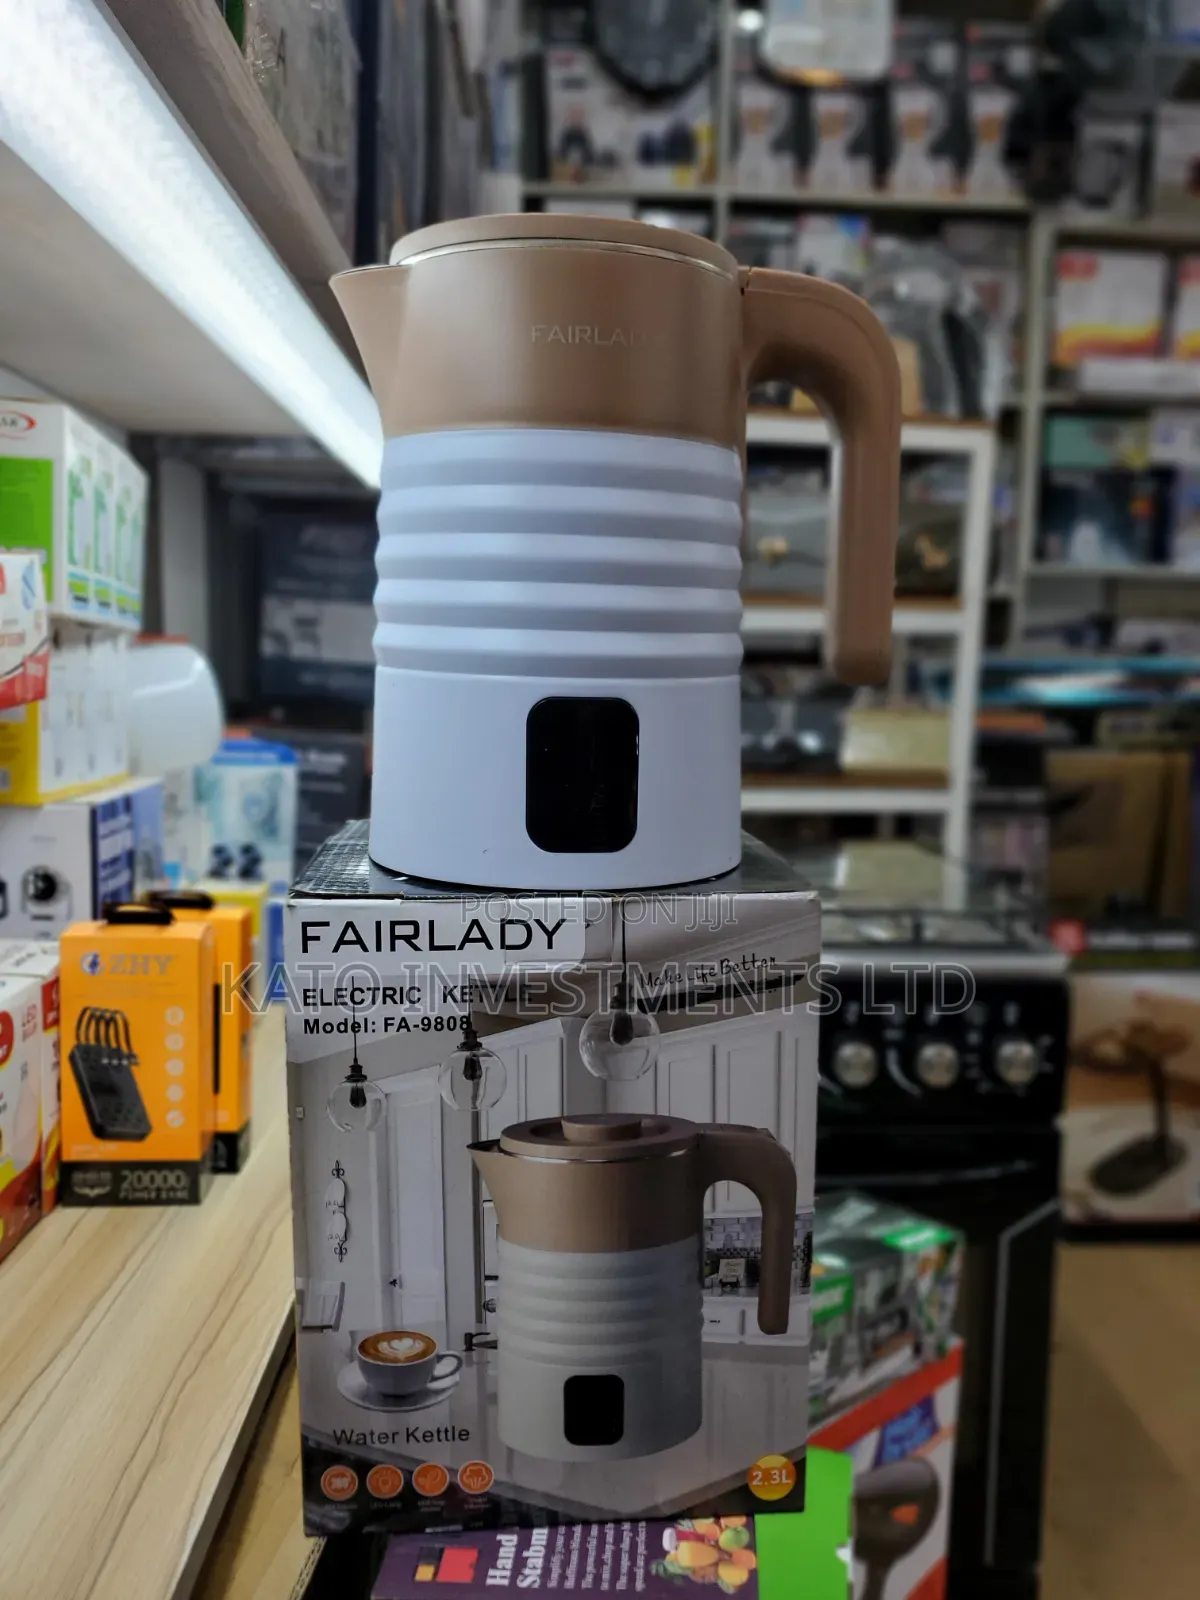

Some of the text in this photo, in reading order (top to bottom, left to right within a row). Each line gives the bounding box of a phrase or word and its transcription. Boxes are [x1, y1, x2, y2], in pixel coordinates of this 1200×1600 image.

[530, 324, 650, 348] FAIRLA
[301, 918, 567, 954] FAIRLADY
[109, 953, 173, 976] ZHY
[302, 986, 422, 1007] ELECTRIC
[303, 1015, 470, 1035] Model: FA-9808
[333, 1425, 470, 1446] Water Kettle
[751, 1469, 792, 1486] 2.3L
[485, 1533, 518, 1587] Hand
